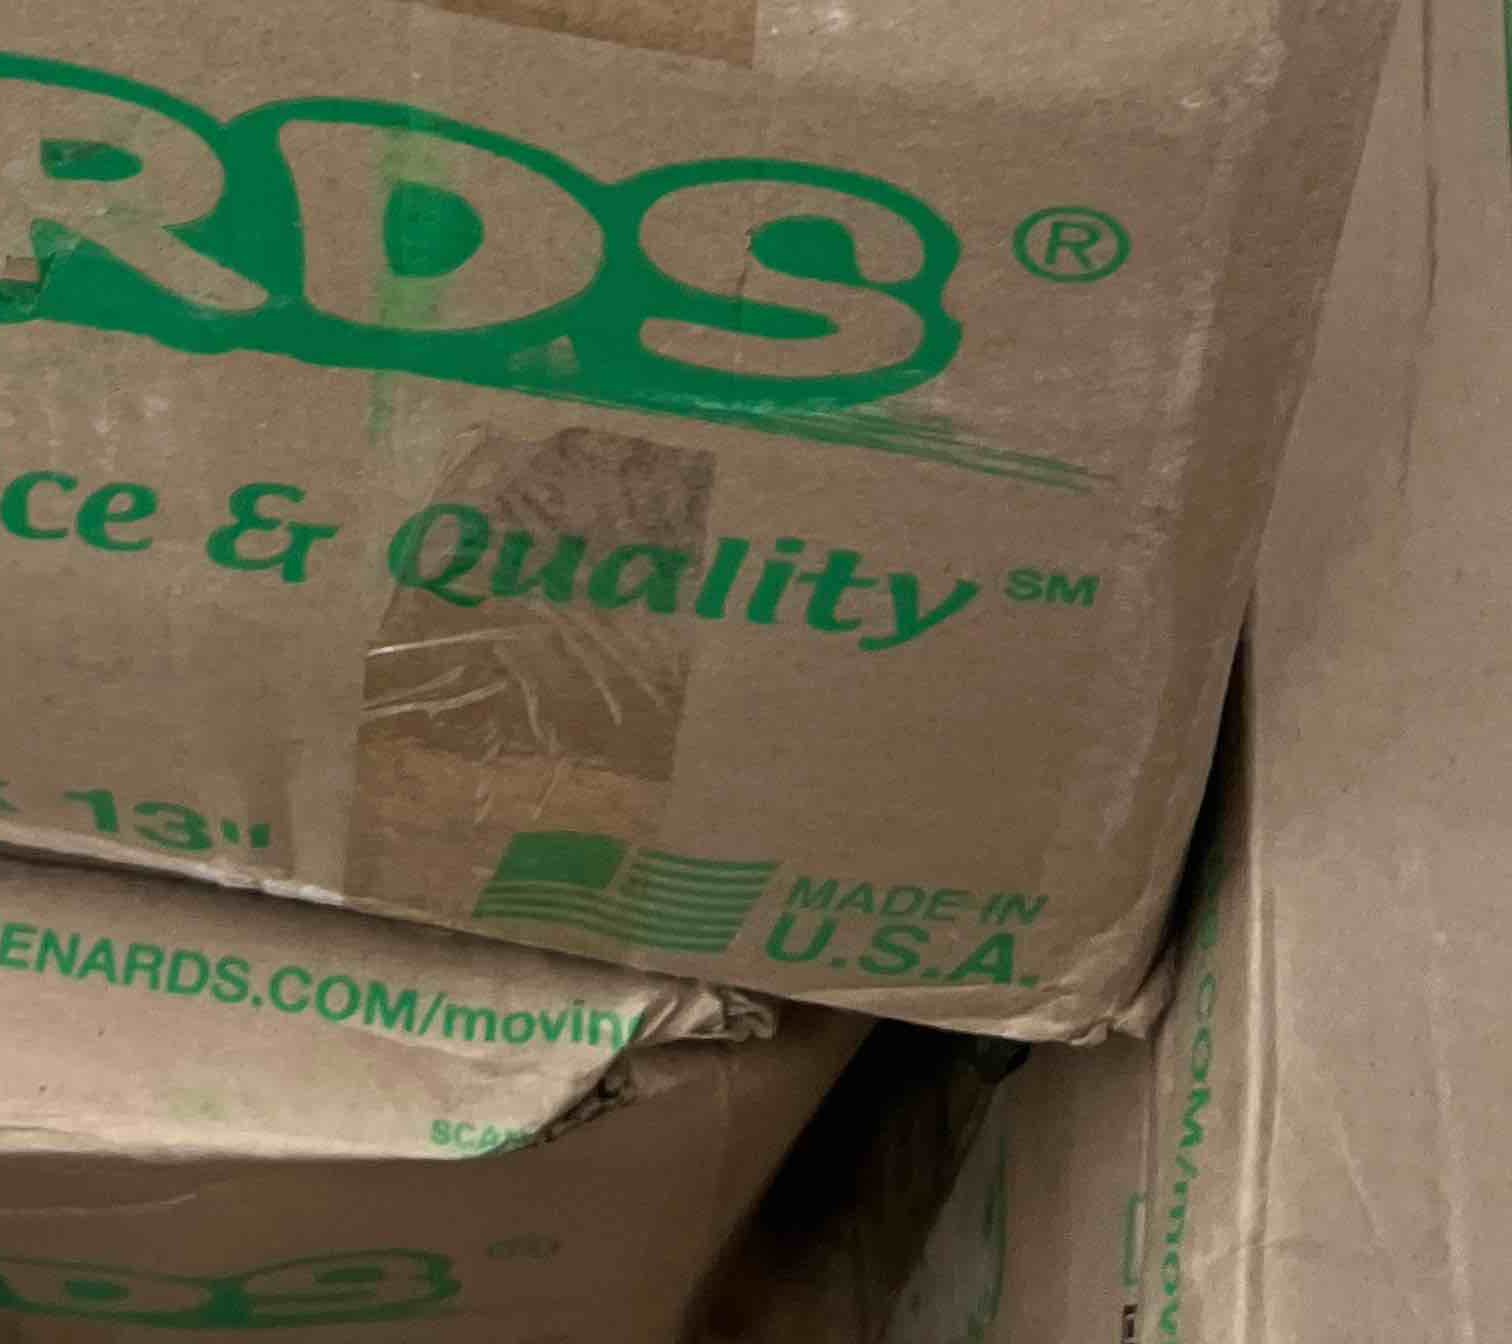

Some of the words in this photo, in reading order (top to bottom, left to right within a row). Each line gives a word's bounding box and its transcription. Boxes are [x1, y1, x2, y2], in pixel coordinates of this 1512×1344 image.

[202, 480, 341, 585] &
[385, 500, 982, 654] Quality
[783, 875, 969, 925] MADE
[976, 892, 1051, 928] IN
[763, 914, 1043, 989] U.S.A.
